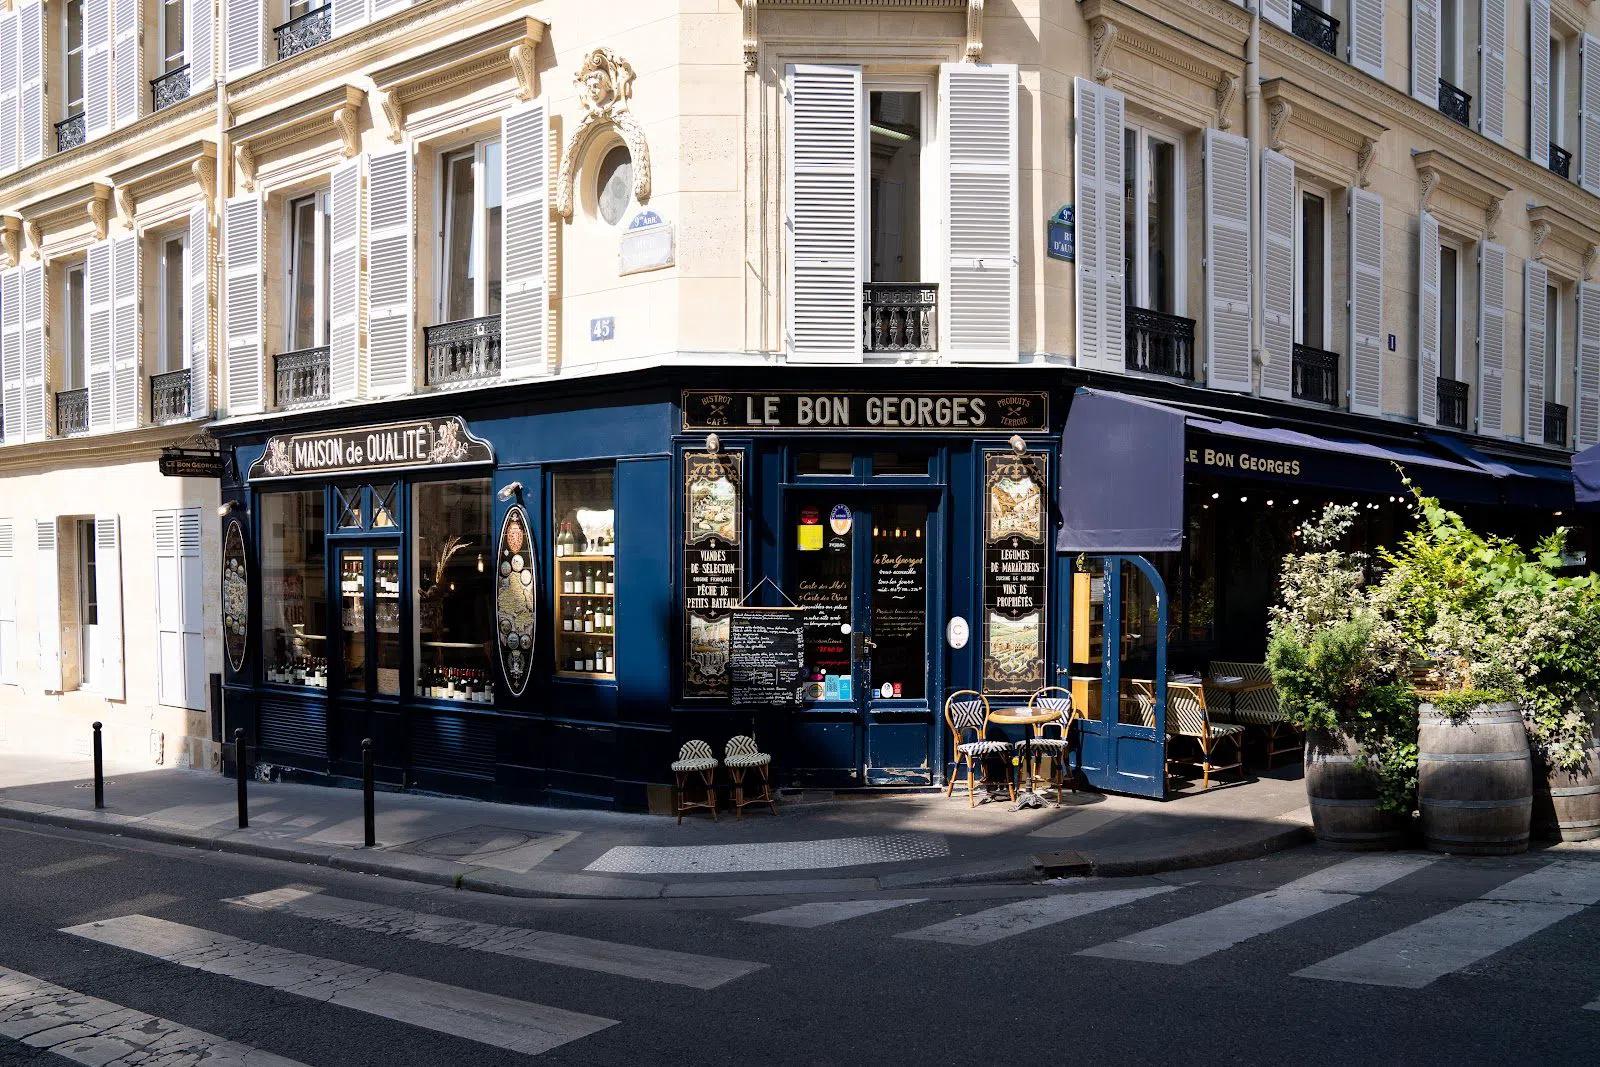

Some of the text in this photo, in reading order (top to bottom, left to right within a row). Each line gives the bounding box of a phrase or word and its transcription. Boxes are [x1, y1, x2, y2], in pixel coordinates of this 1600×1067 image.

[593, 320, 610, 338] 45
[701, 394, 733, 406] BISTROT
[997, 397, 1031, 408] PRODUITS
[746, 396, 986, 427] LE BON GEORGES
[706, 416, 729, 426] CAFÉ
[1000, 416, 1029, 427] TERROIR
[295, 427, 427, 469] MAISON de QUALITÉ
[191, 461, 223, 469] GEORGES
[1185, 448, 1301, 476] E BON GEORGES
[700, 550, 726, 561] VIANDES
[881, 554, 895, 565] Bon
[893, 554, 923, 569] Georges
[990, 561, 1040, 573] DE MARAÎCHERS
[690, 563, 735, 574] DE SÉLECTION
[697, 584, 729, 596] PÊCHE DE
[799, 580, 818, 590] Carte
[1003, 584, 1028, 594] VINS DE
[687, 598, 739, 608] PETITS BATEAUX
[996, 596, 1033, 607] PROPRIÉTÉS
